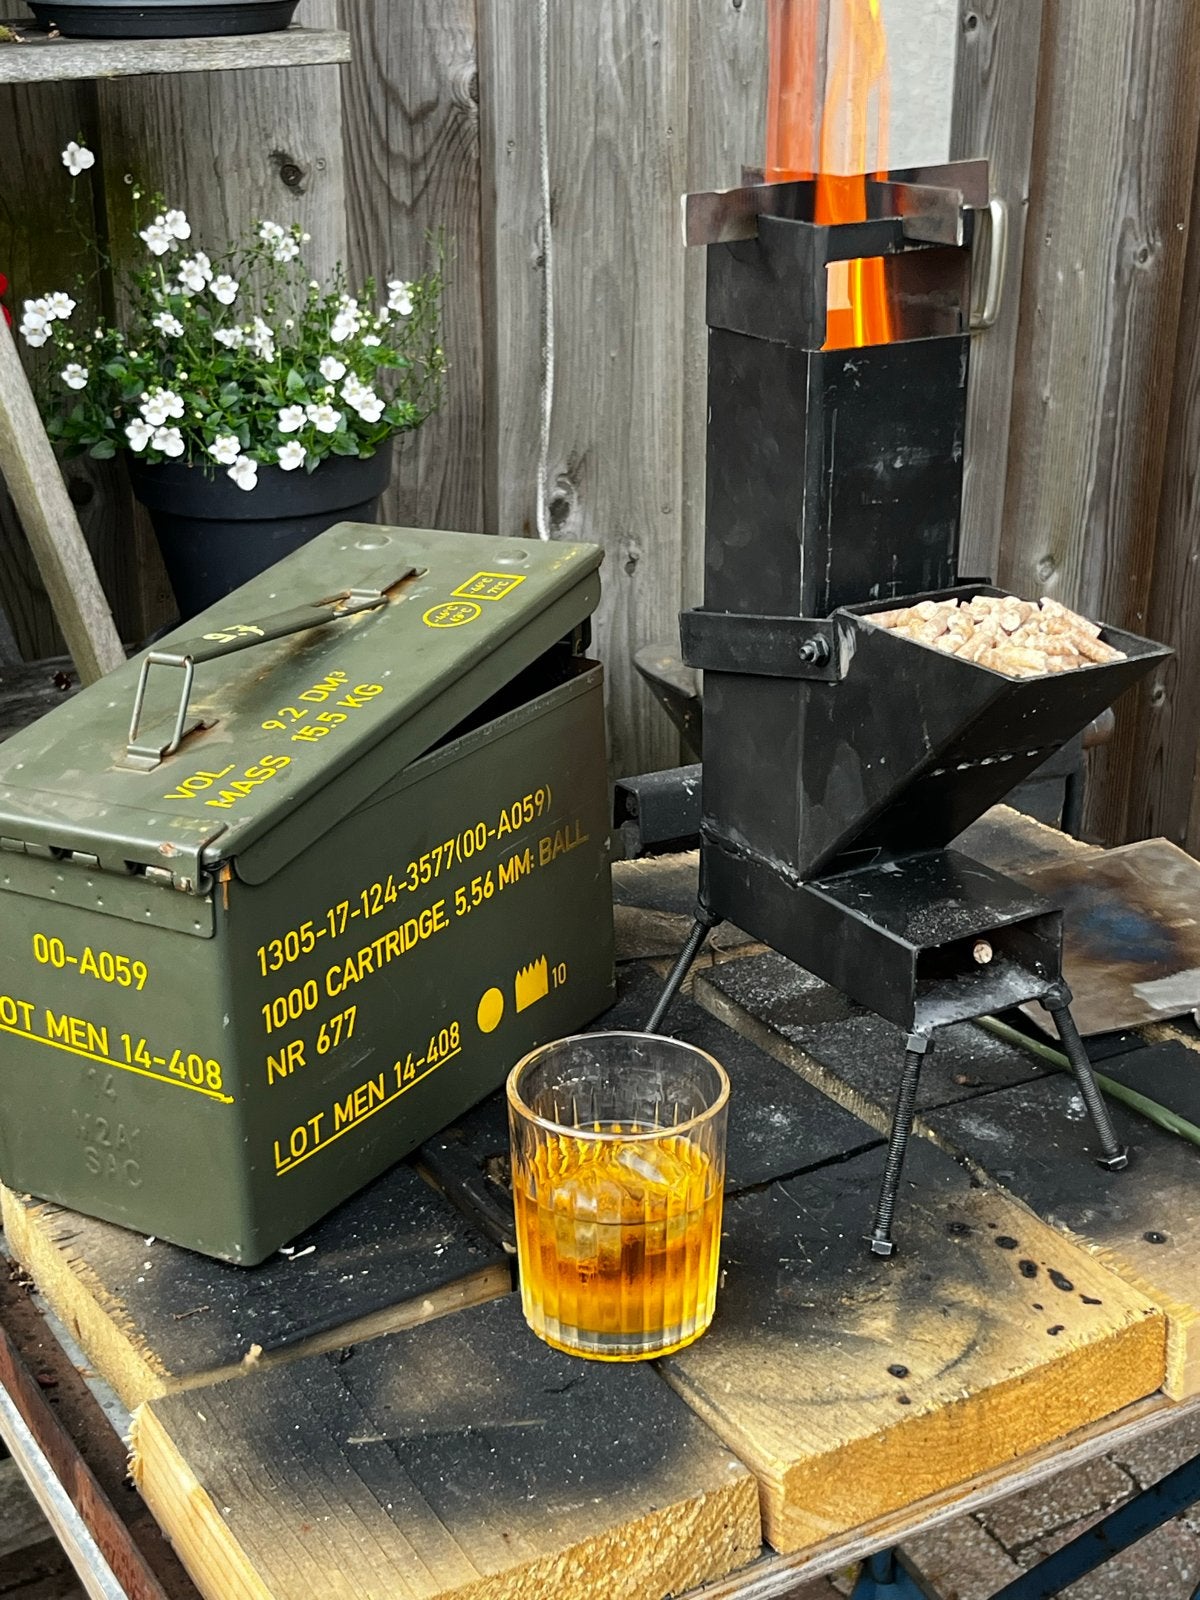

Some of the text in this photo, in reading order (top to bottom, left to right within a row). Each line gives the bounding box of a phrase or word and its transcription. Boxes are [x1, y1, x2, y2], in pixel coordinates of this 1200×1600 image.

[164, 764, 236, 799] VOL.
[261, 706, 309, 731] 9.2
[204, 683, 384, 809] MASS 15.5 KG
[32, 932, 148, 991] 00-A059
[262, 819, 590, 1035] 1000 CARTRIDGE, 5,56 MM: BALL
[552, 962, 567, 988] 10
[0, 995, 35, 1031] OT
[45, 1009, 109, 1056] MEN
[121, 1033, 222, 1091] 14-408
[266, 1005, 357, 1086] NR 677
[273, 1021, 460, 1169] LOT MEN 14-408
